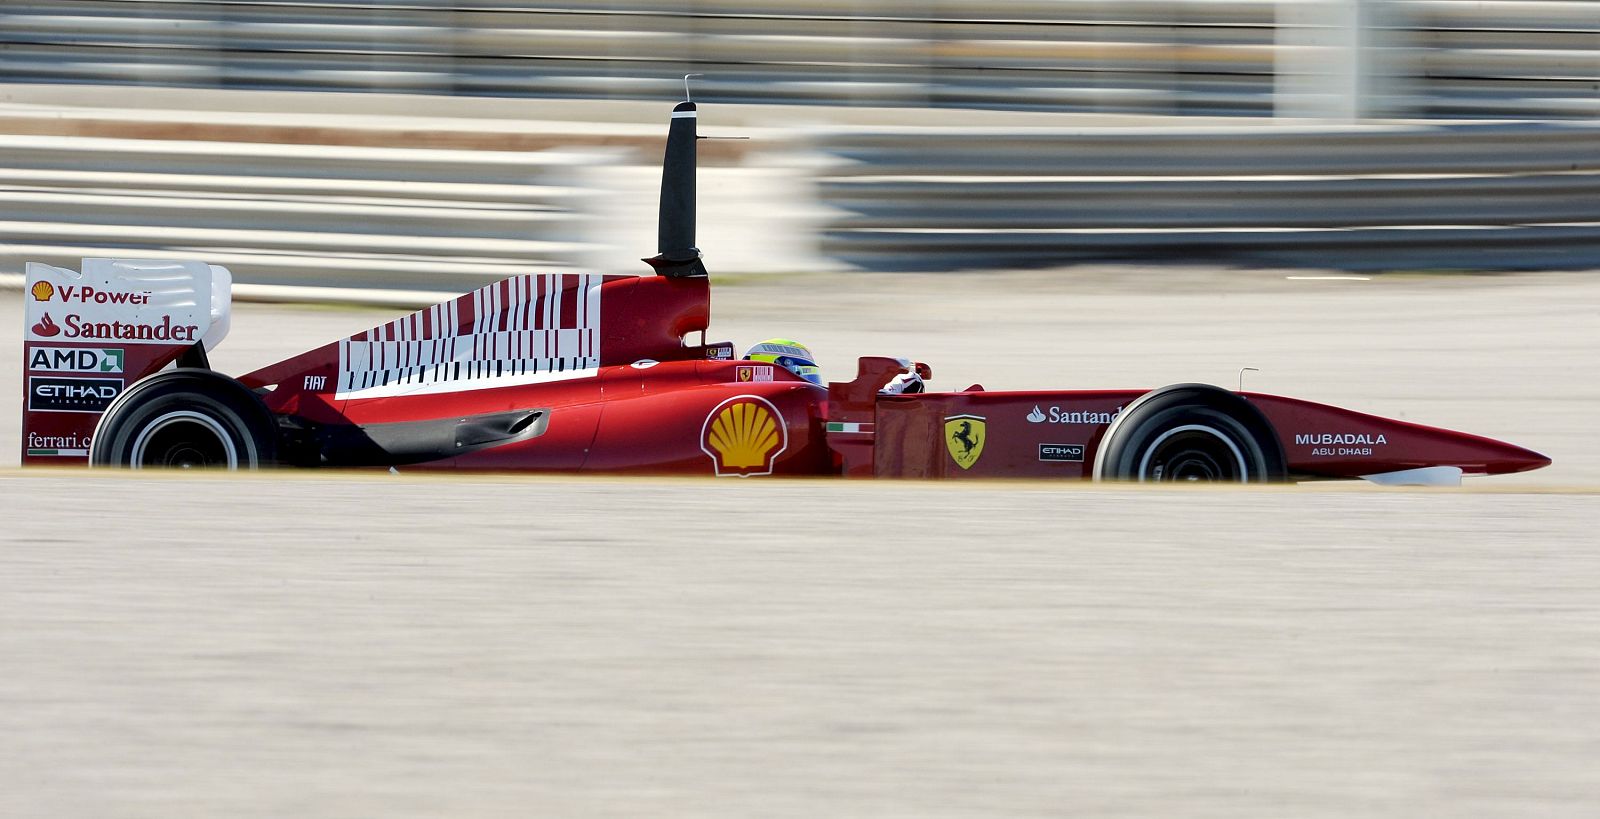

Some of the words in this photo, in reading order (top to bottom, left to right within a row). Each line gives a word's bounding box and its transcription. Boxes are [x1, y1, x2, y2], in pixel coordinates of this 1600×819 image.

[58, 285, 152, 305] V-Power
[64, 314, 198, 341] Santander
[30, 349, 98, 370] AMD
[303, 375, 327, 390] FIAT
[36, 385, 117, 398] ETIHAD
[1295, 434, 1387, 445] MUBADALA
[1042, 447, 1081, 455] ETIHAD
[1311, 448, 1335, 456] ABU
[1338, 448, 1372, 456] DHABI
